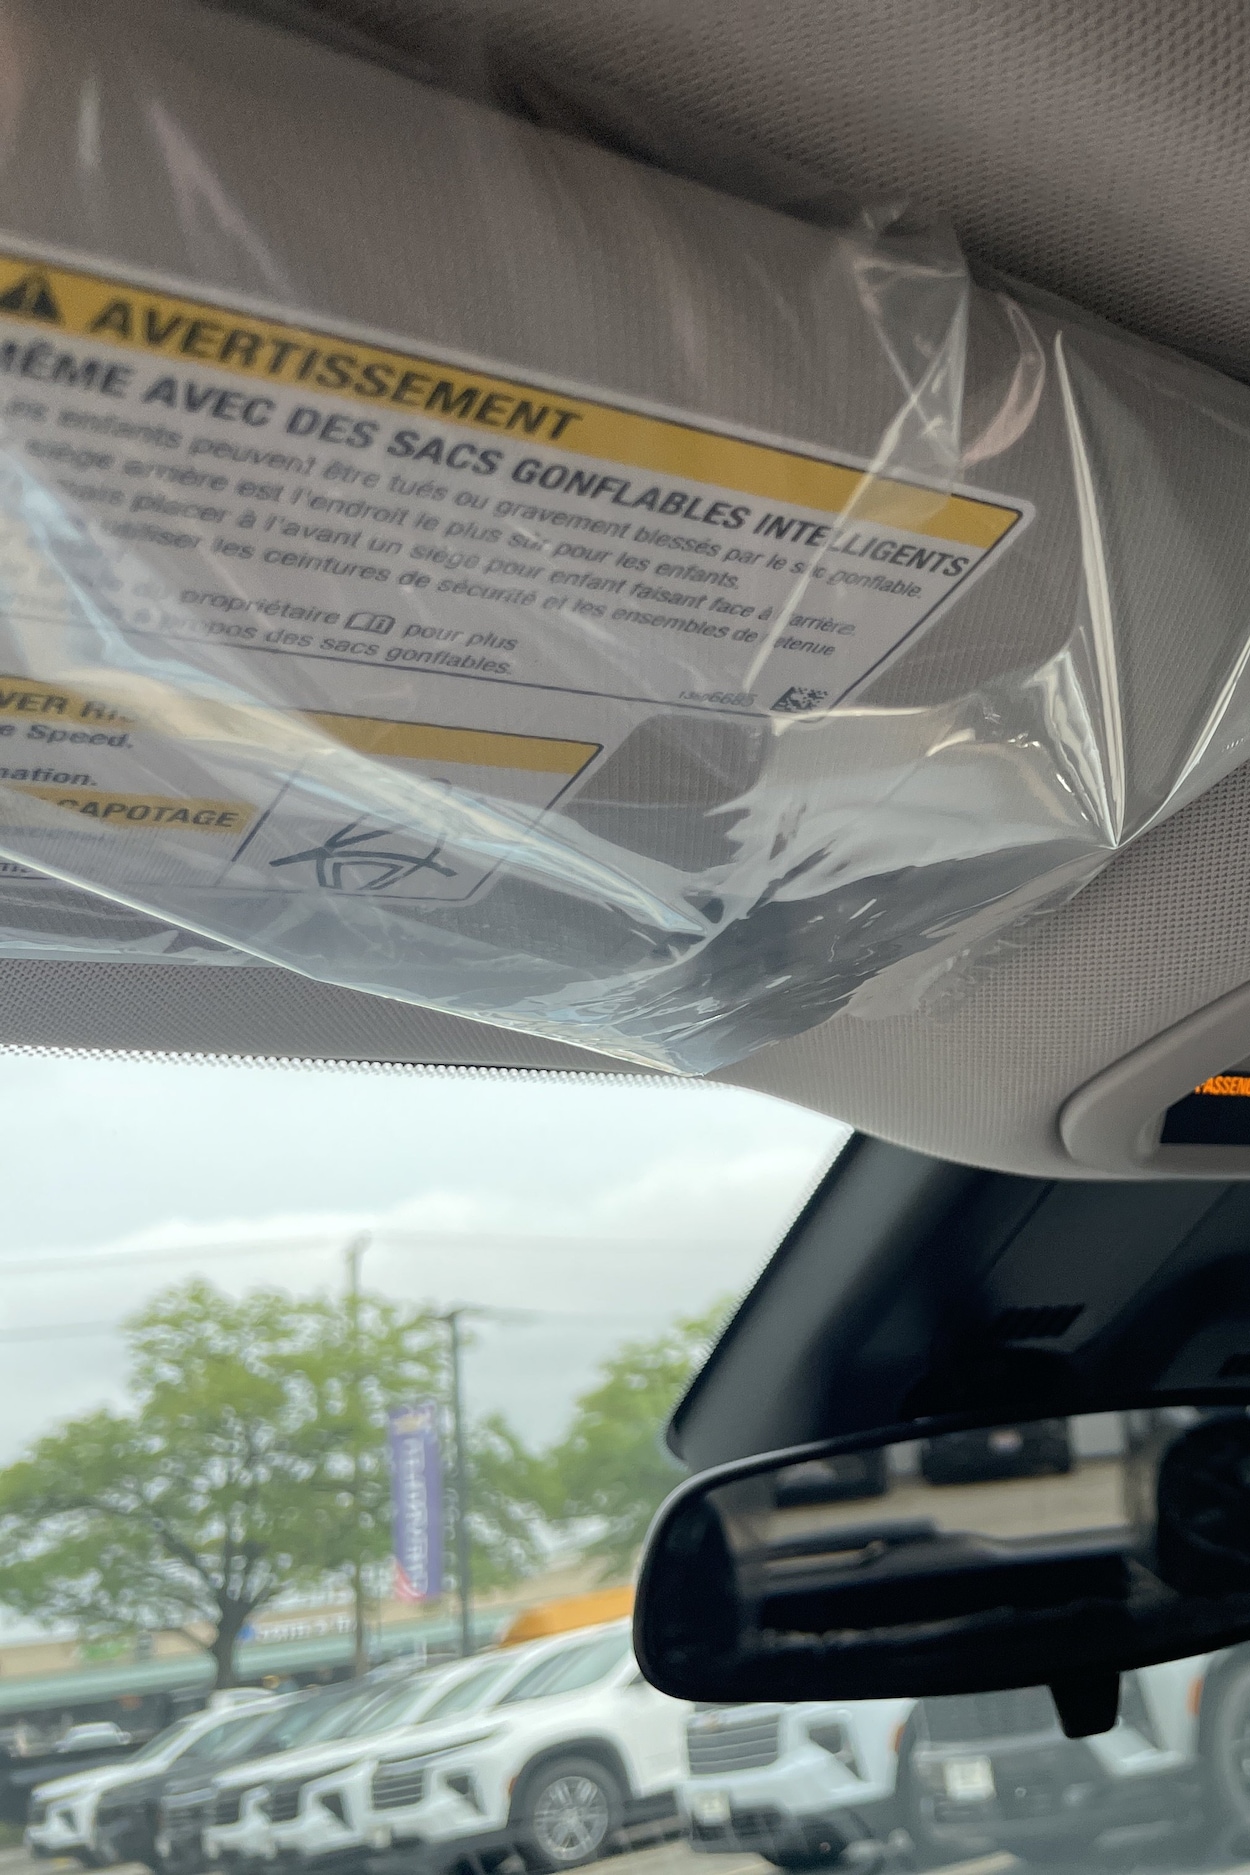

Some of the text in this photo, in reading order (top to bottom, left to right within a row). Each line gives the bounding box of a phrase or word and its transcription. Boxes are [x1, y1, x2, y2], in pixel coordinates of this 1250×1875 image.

[87, 298, 583, 440] AVERTISSEMENT
[142, 376, 275, 427] AVEC
[286, 407, 379, 448] DES
[387, 430, 503, 476] SACS
[511, 458, 750, 530] GONFLABLES
[189, 437, 317, 476] peuvent
[388, 473, 448, 501] tués
[454, 490, 489, 511] ou
[493, 500, 632, 539] gravement
[633, 526, 721, 558] blessés
[723, 548, 764, 569] par
[766, 553, 788, 571] le
[263, 514, 362, 548] l'avant
[367, 536, 402, 554] un
[483, 557, 545, 580] pour
[547, 569, 627, 597] enfant
[629, 581, 707, 610] faisant
[708, 597, 755, 618] face
[263, 549, 392, 583] ceintures
[398, 568, 431, 587] de
[571, 598, 607, 618] les
[611, 607, 730, 639] ensembles
[732, 627, 758, 643] de
[763, 633, 836, 656] etenue
[414, 511, 440, 532] le
[445, 518, 503, 543] plus
[553, 541, 612, 564] pour
[615, 551, 650, 572] les
[655, 562, 739, 590] enfants.
[264, 628, 313, 648] des
[319, 637, 380, 657] sacs
[384, 648, 513, 677] gonflables.
[402, 622, 464, 642] pour
[465, 631, 518, 652] plus
[27, 723, 134, 749] Speed.
